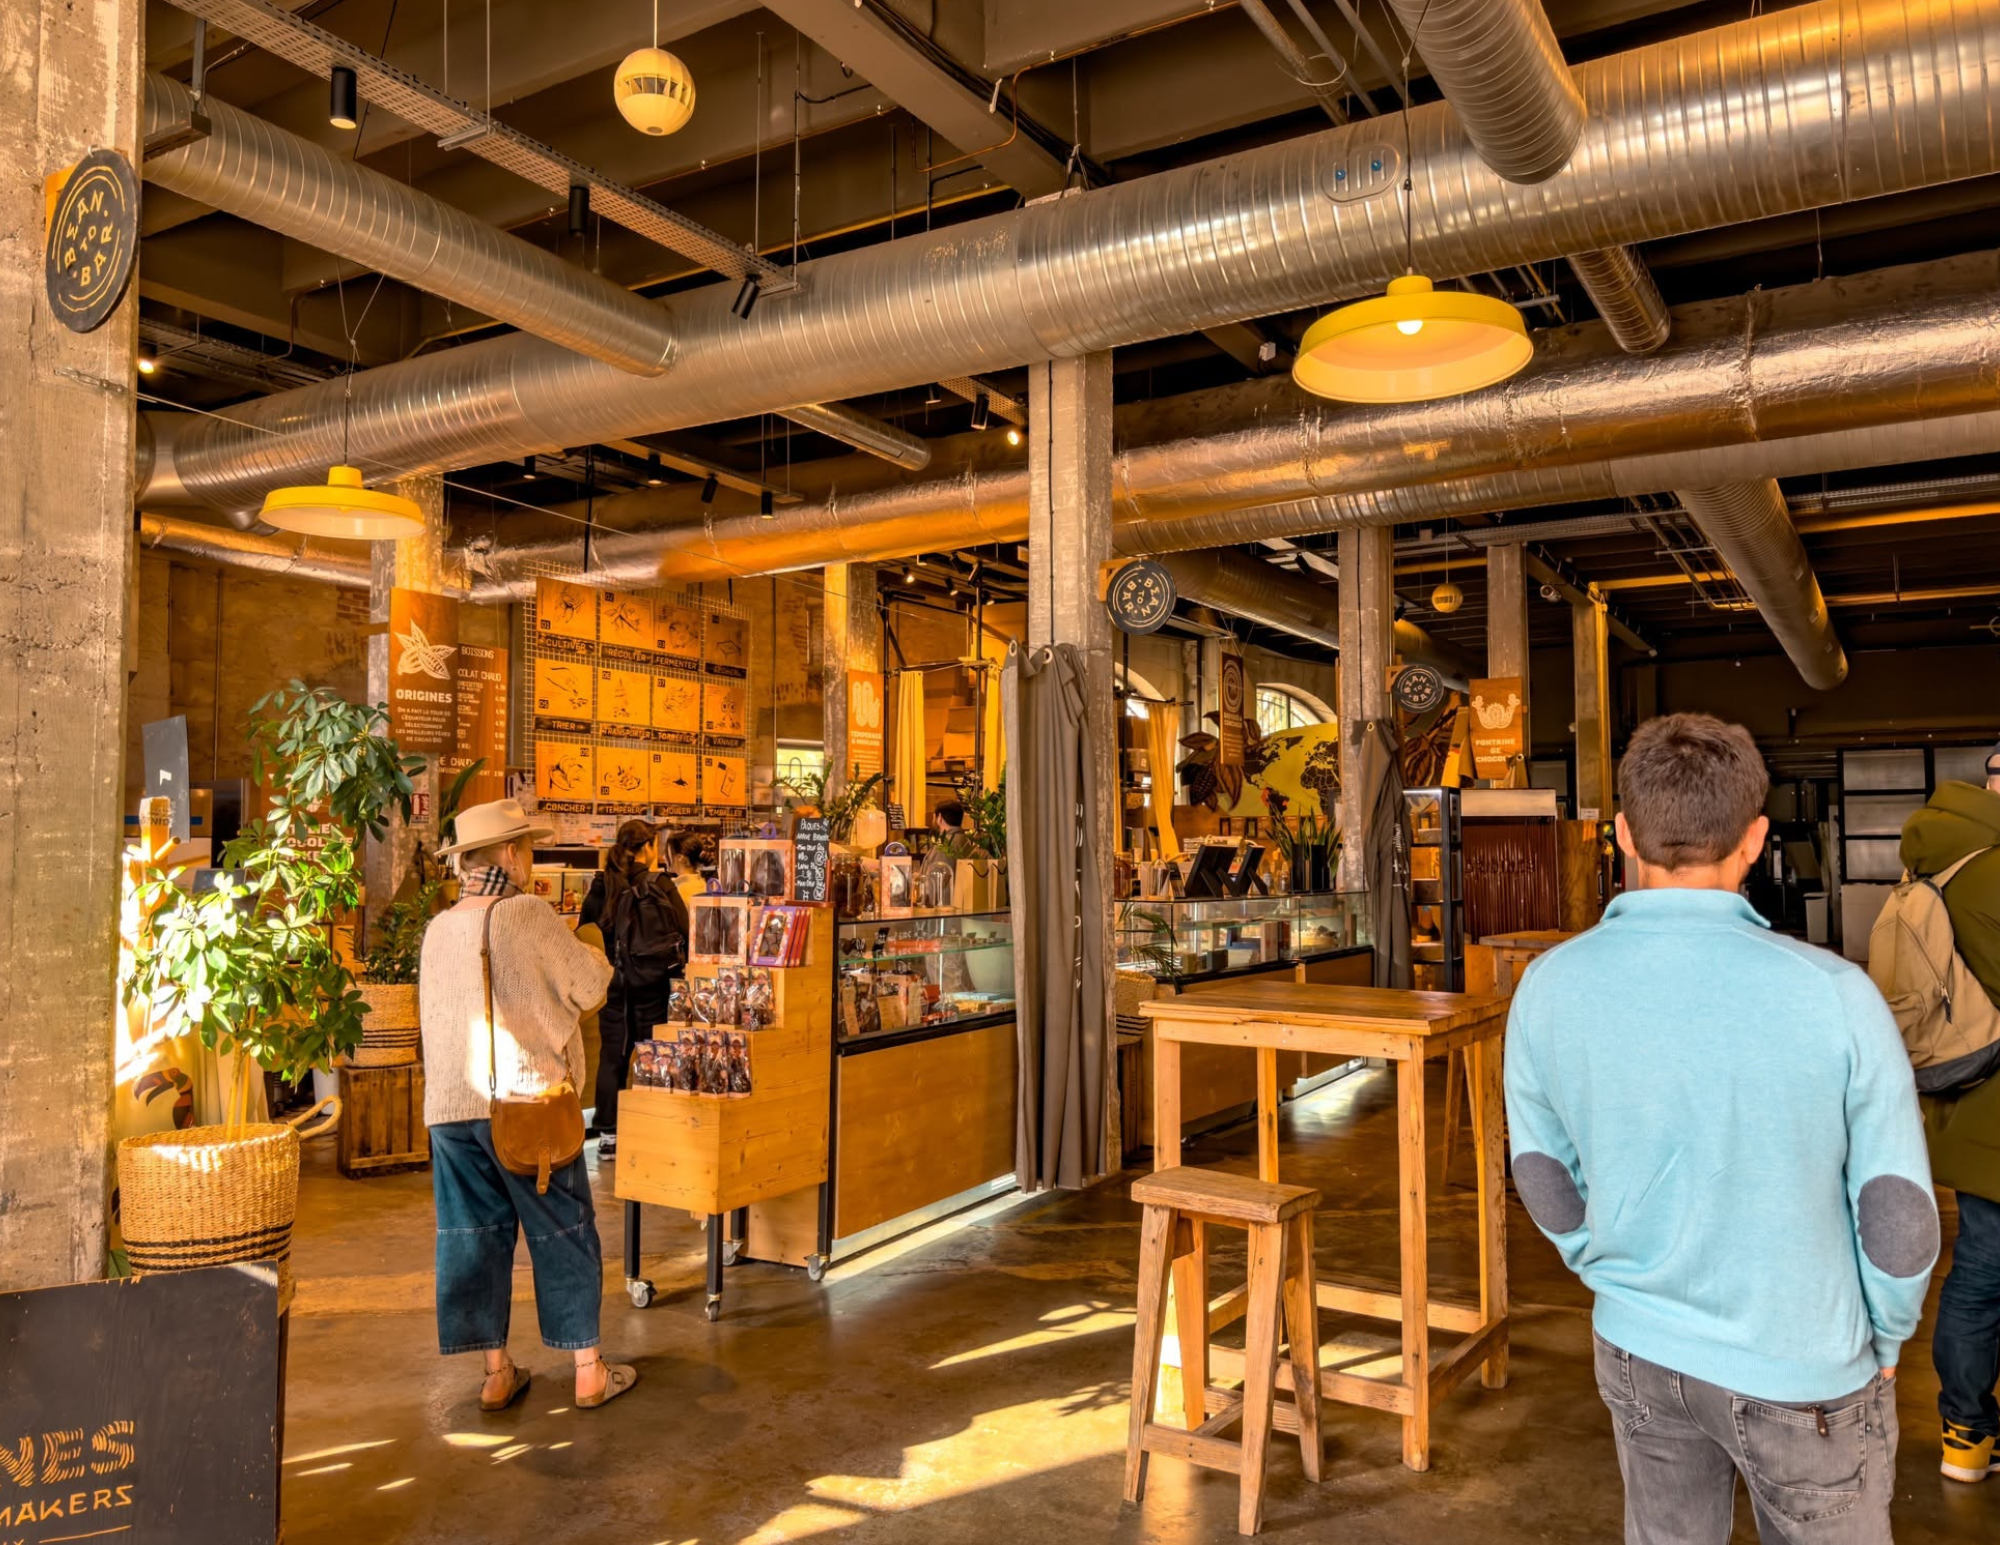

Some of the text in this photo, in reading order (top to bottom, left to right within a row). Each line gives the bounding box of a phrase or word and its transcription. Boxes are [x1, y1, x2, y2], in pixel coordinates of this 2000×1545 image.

[65, 190, 105, 268] BEAN
[80, 225, 97, 252] TO
[80, 221, 114, 287] BAR
[1122, 580, 1137, 613] BAR
[1136, 590, 1145, 604] TO
[1141, 577, 1160, 617] BEAN
[546, 638, 586, 652] CULTIVER
[461, 646, 495, 659] BOISSONS
[656, 656, 698, 670] FERMENTER
[457, 668, 502, 682] COLAT CHAUD
[1403, 675, 1427, 694] BEAN
[395, 689, 453, 703] ORIGINES
[1413, 687, 1432, 702] BAR
[552, 721, 576, 731] TRIER
[602, 727, 651, 740] TRANSPORTER
[546, 803, 586, 813] CONCHER
[663, 806, 691, 815] MOULER
[709, 808, 743, 816] EMBALLER
[0, 1421, 135, 1487] NES
